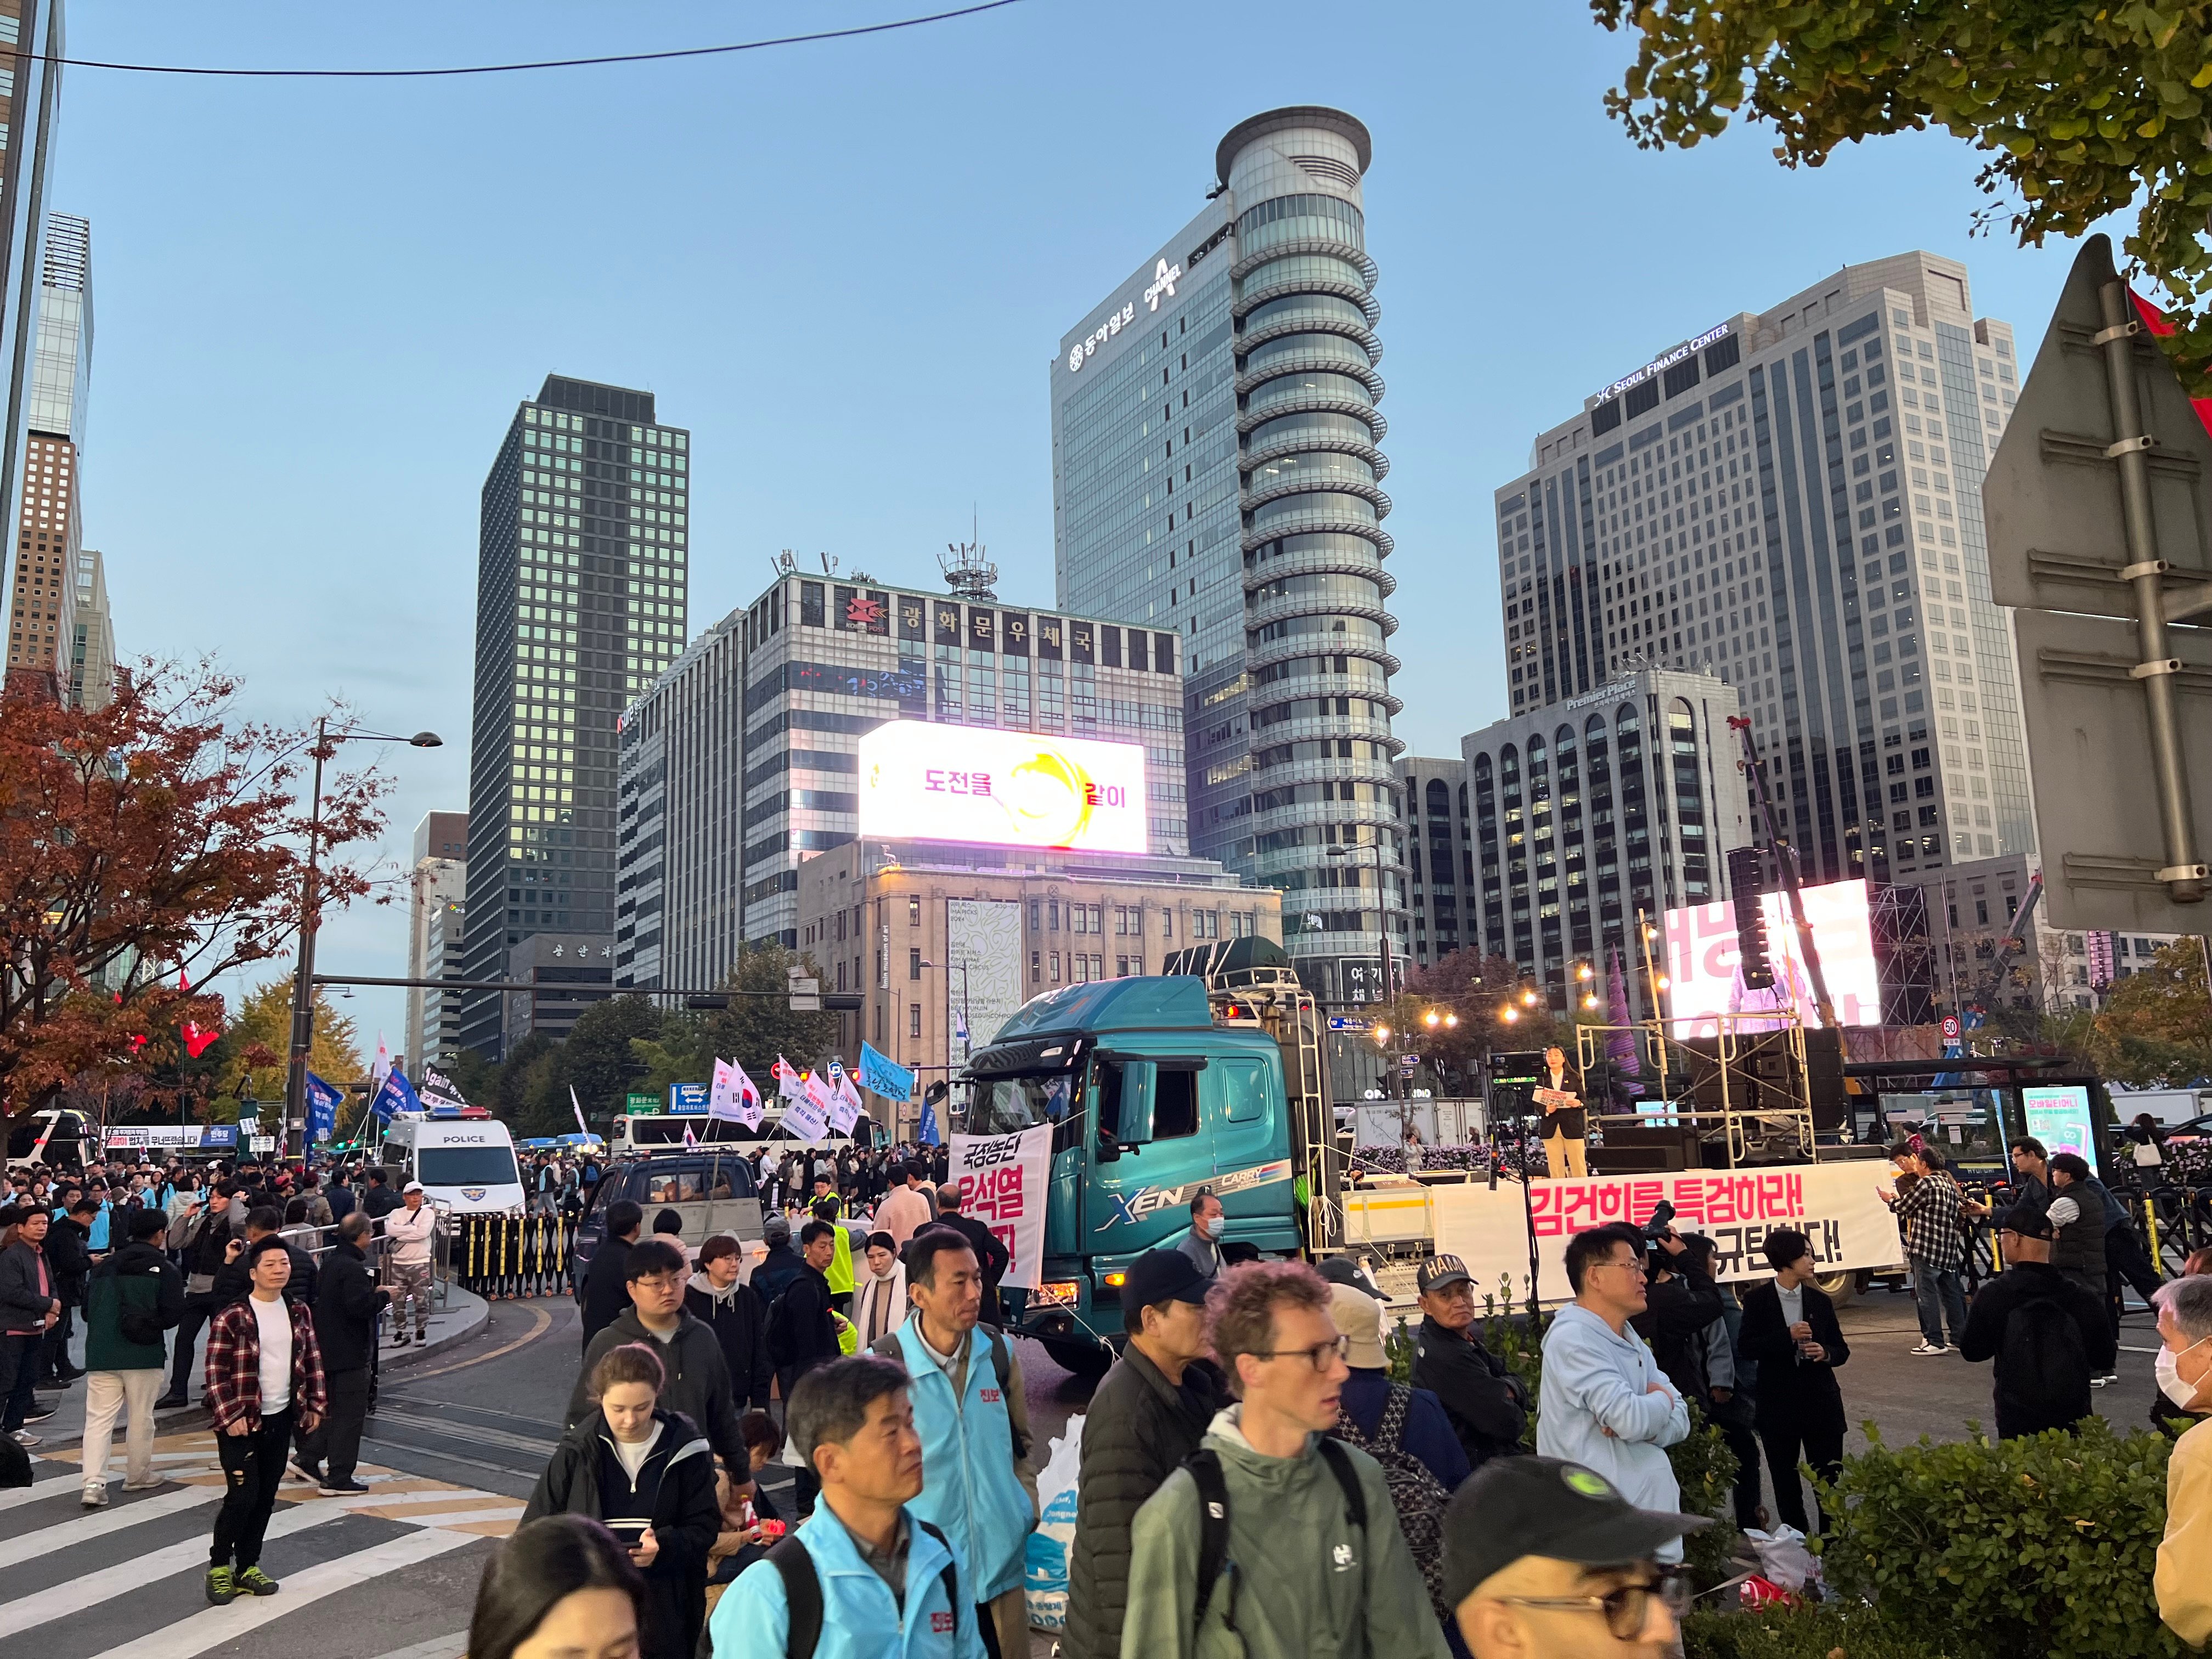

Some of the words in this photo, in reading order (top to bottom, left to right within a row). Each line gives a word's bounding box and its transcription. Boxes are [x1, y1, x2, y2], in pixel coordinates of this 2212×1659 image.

[1144, 263, 1181, 303] CHANNEL
[1085, 302, 1134, 356] 동아일보
[1615, 371, 1645, 394] SEOUL
[1647, 346, 1689, 376] FINANCE
[1690, 323, 1728, 352] CENTER
[869, 625, 885, 634] POST
[902, 606, 1091, 652] 광화문우체국
[1567, 690, 1606, 710] Premier
[1607, 680, 1635, 696] Place
[925, 769, 992, 796] 도전을
[1085, 782, 1125, 808] 같이
[1945, 1022, 1955, 1032] 50
[799, 1094, 827, 1117] 더불어민주당
[2029, 1098, 2078, 1108] 모바일티머니
[210, 1130, 229, 1138] 민주당
[963, 1132, 1024, 1170] 국정농단
[958, 1164, 1023, 1221] 윤석열
[1222, 1167, 1263, 1187] CARRY
[1530, 1181, 1664, 1237] 김건희를
[1674, 1173, 1804, 1224] 특검하라!
[1716, 1218, 1843, 1274] 규탄다!
[980, 1389, 1000, 1402] 진보
[1047, 1510, 1076, 1519] Jongno
